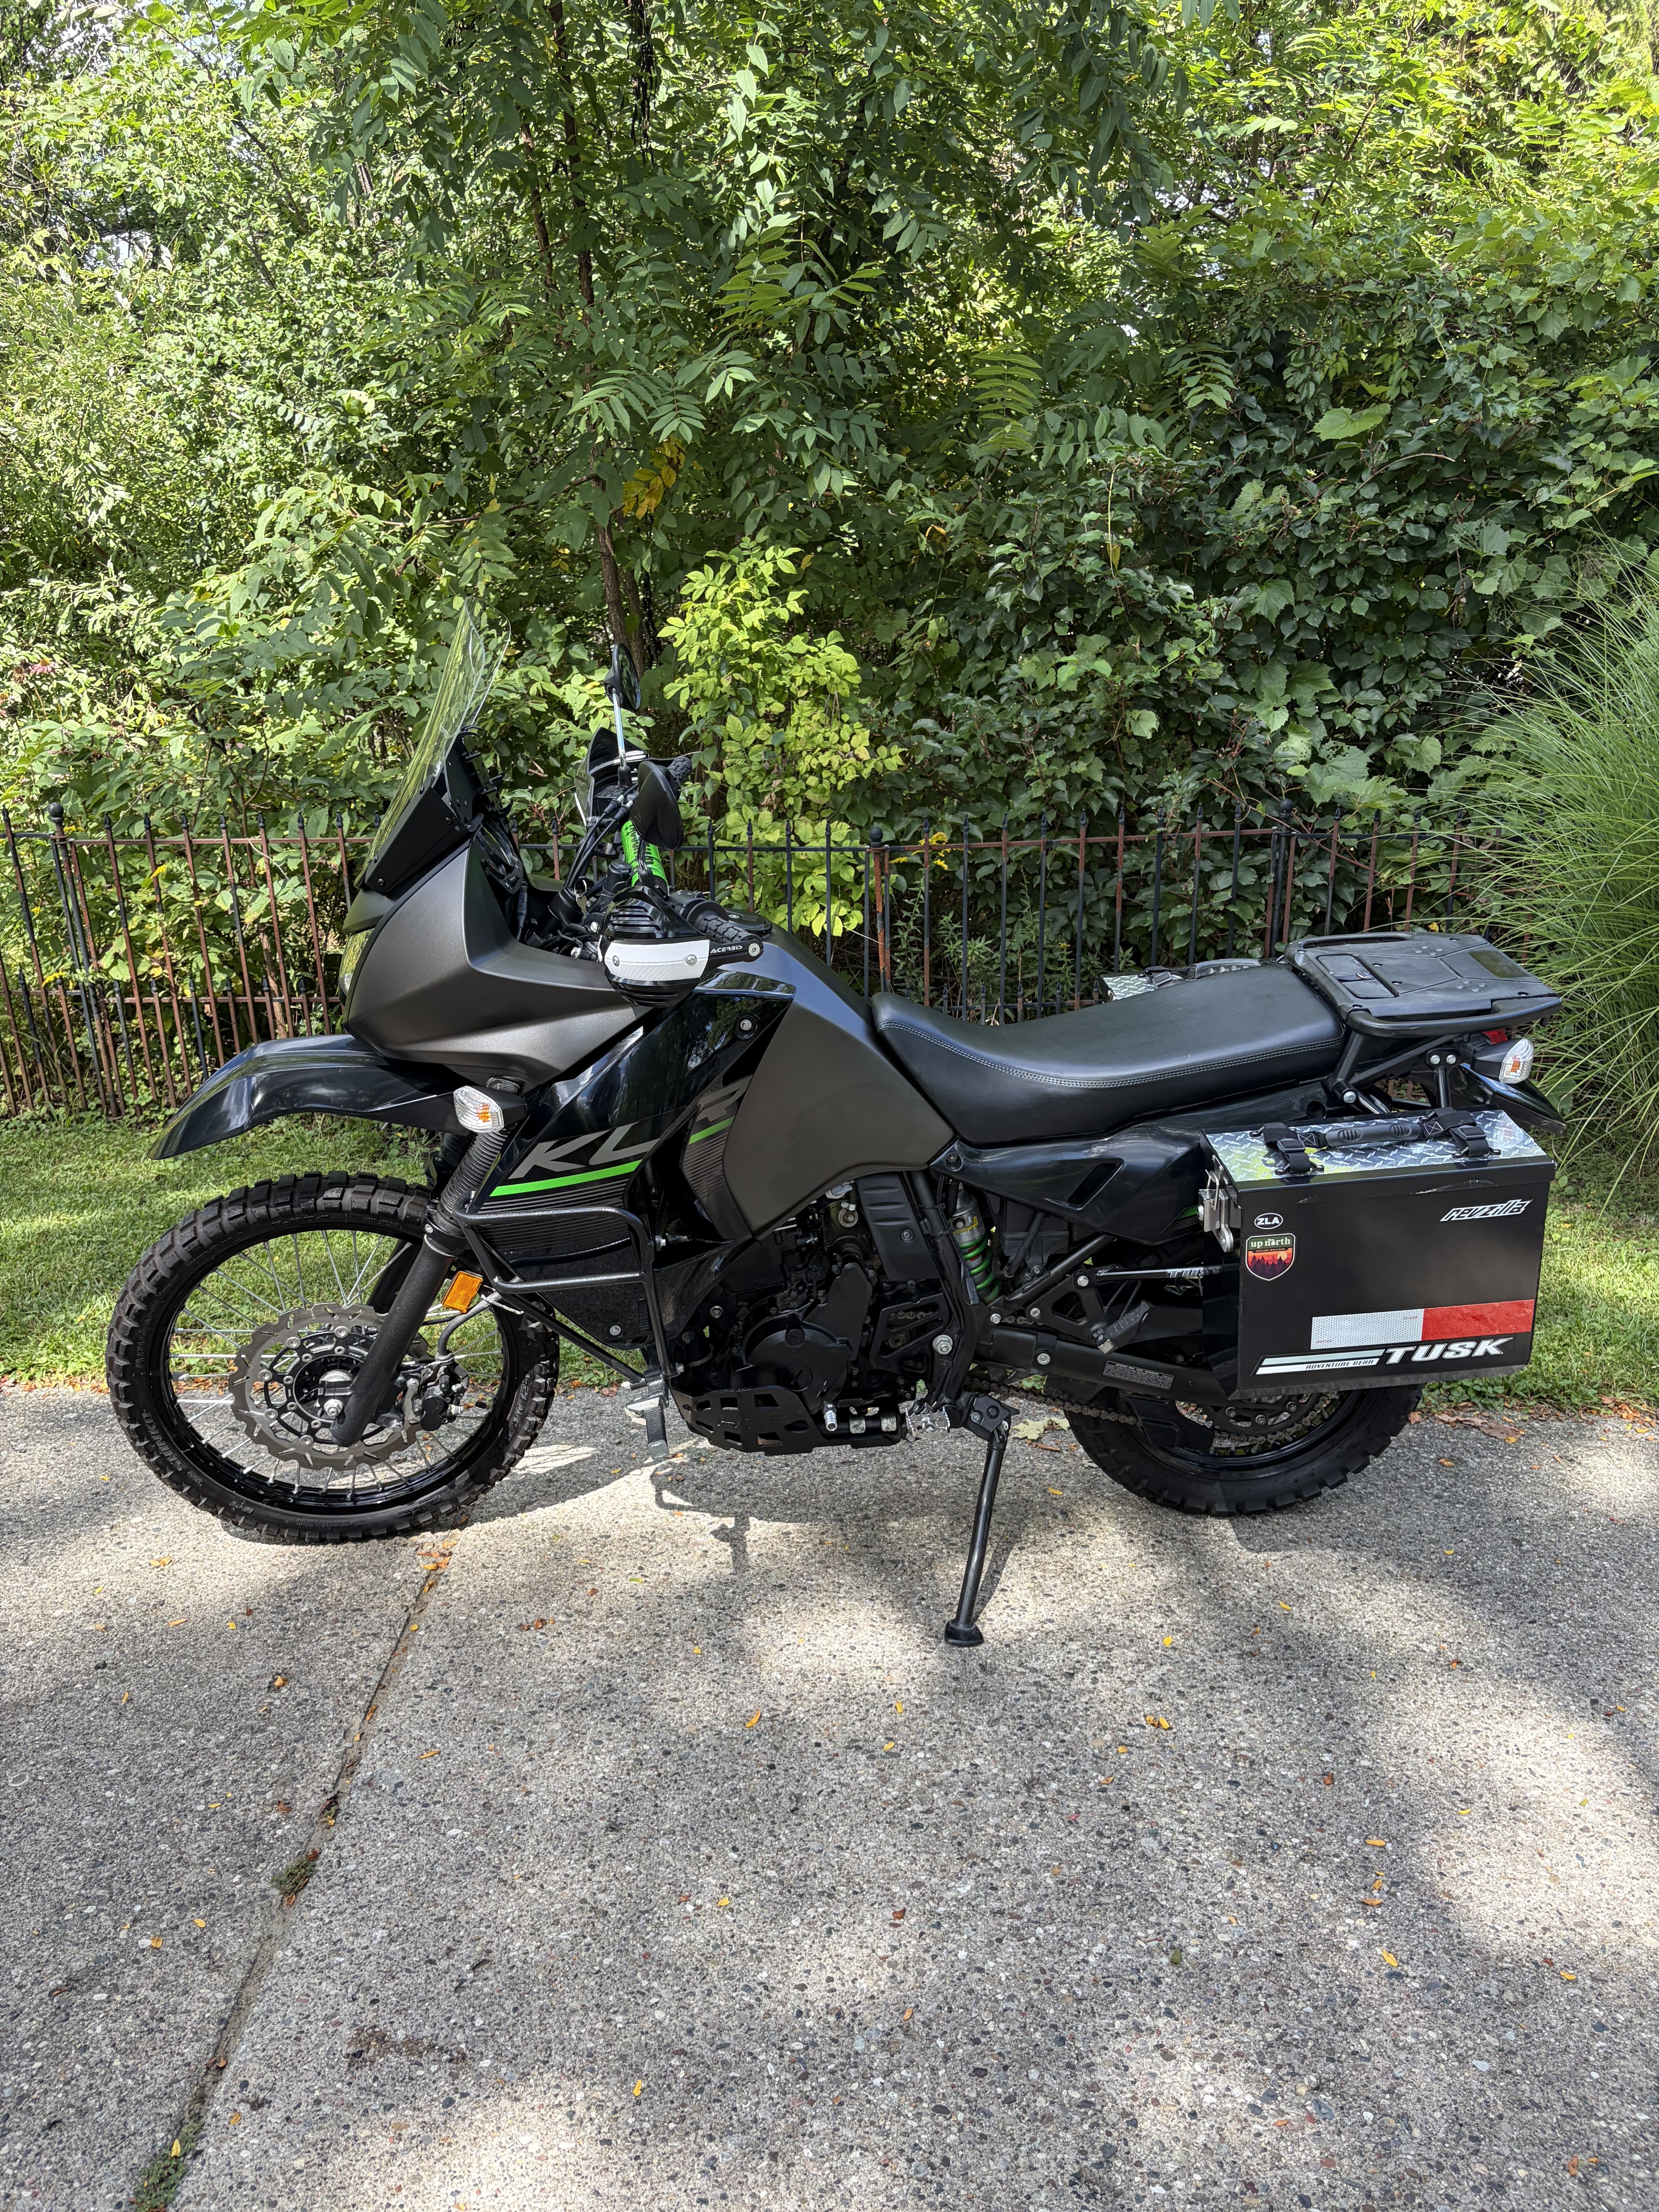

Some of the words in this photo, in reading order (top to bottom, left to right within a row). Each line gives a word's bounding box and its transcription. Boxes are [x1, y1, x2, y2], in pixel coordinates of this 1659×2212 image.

[710, 945, 743, 953] ACERBIS
[1257, 1217, 1279, 1225] ZLA
[1386, 1337, 1513, 1365] TUSK
[1305, 1361, 1350, 1370] ADVENTURE
[141, 1412, 187, 1472] SHINKO
